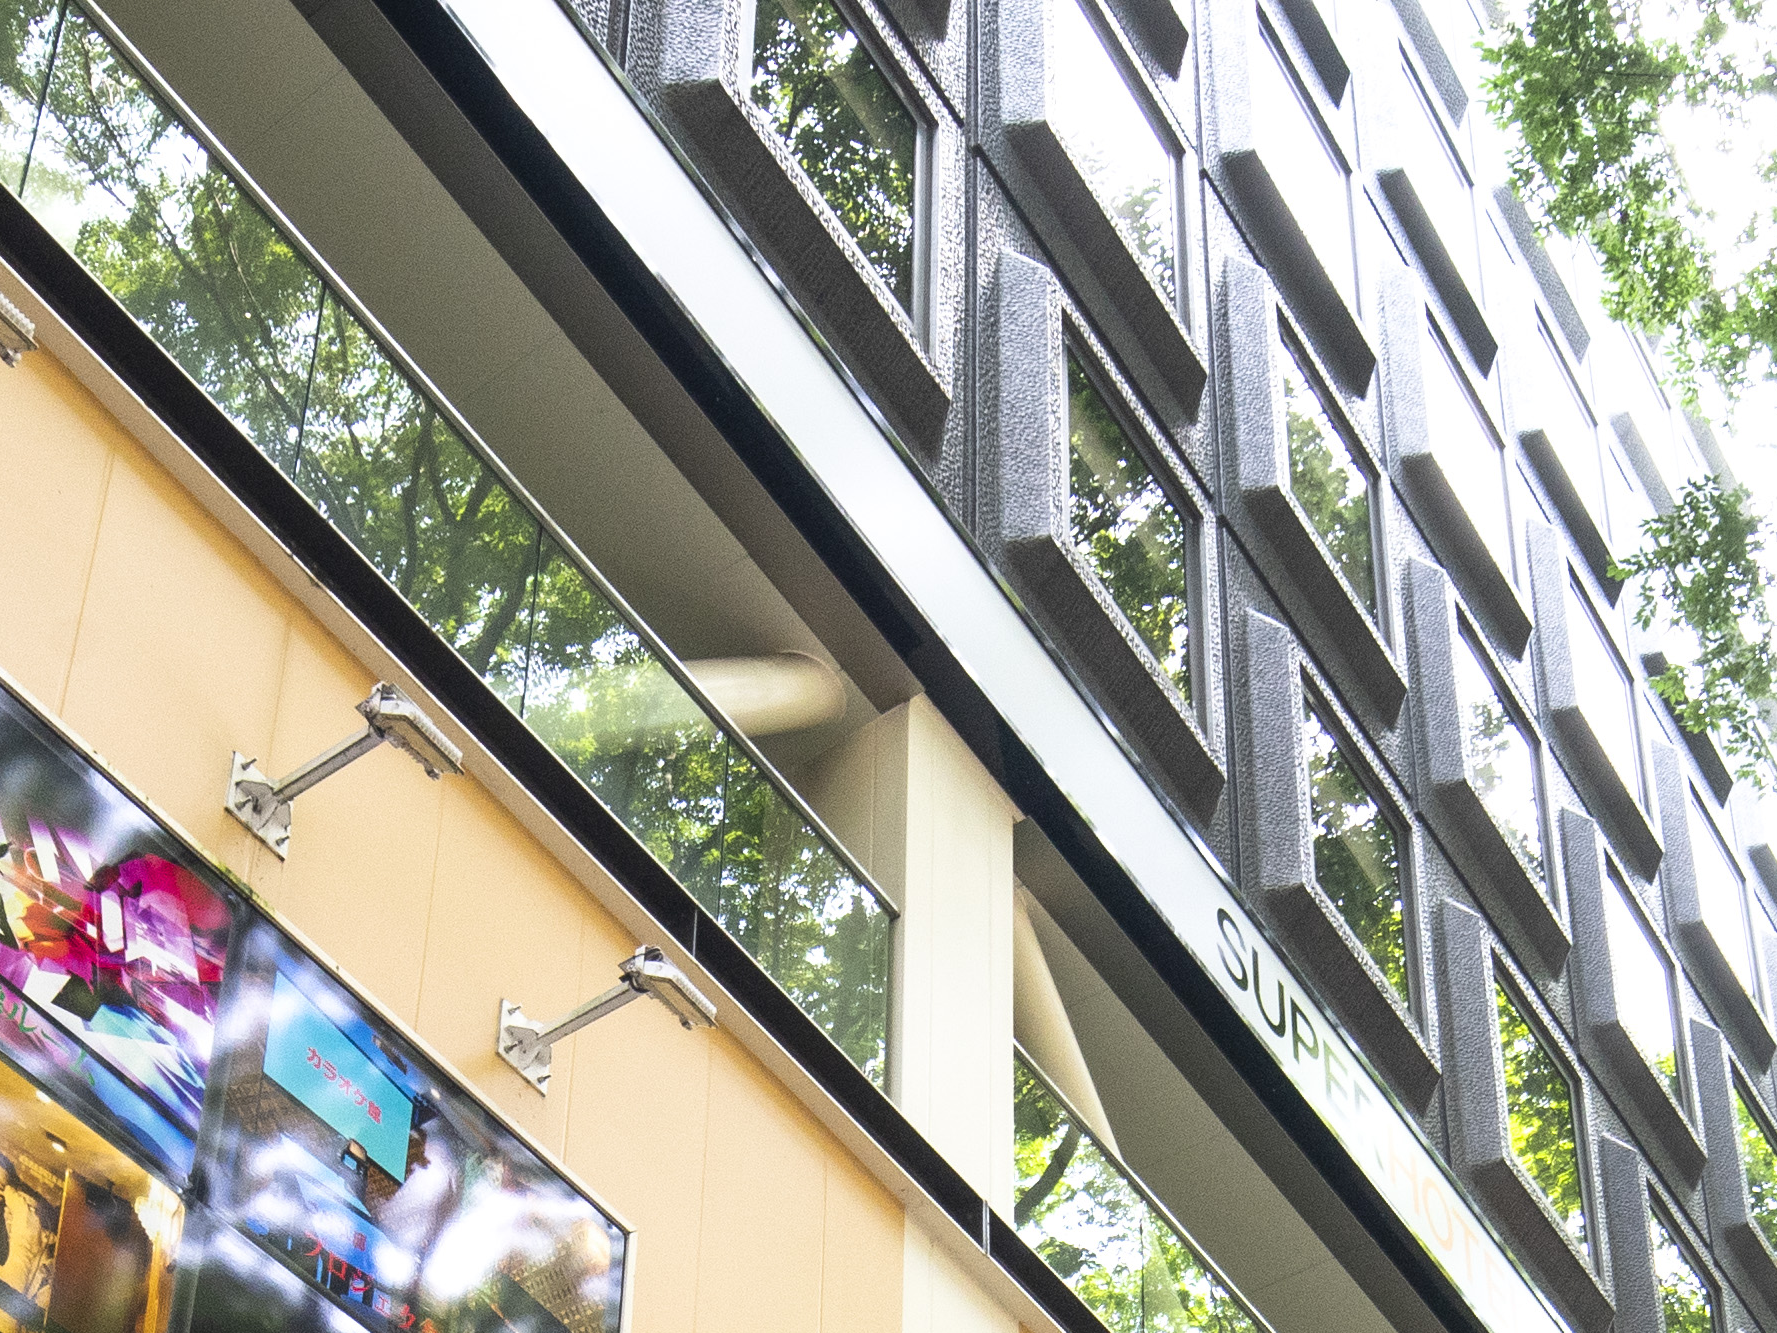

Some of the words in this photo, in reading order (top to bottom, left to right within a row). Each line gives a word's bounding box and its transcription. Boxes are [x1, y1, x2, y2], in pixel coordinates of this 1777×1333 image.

[306, 1046, 382, 1125] カラオケ館
